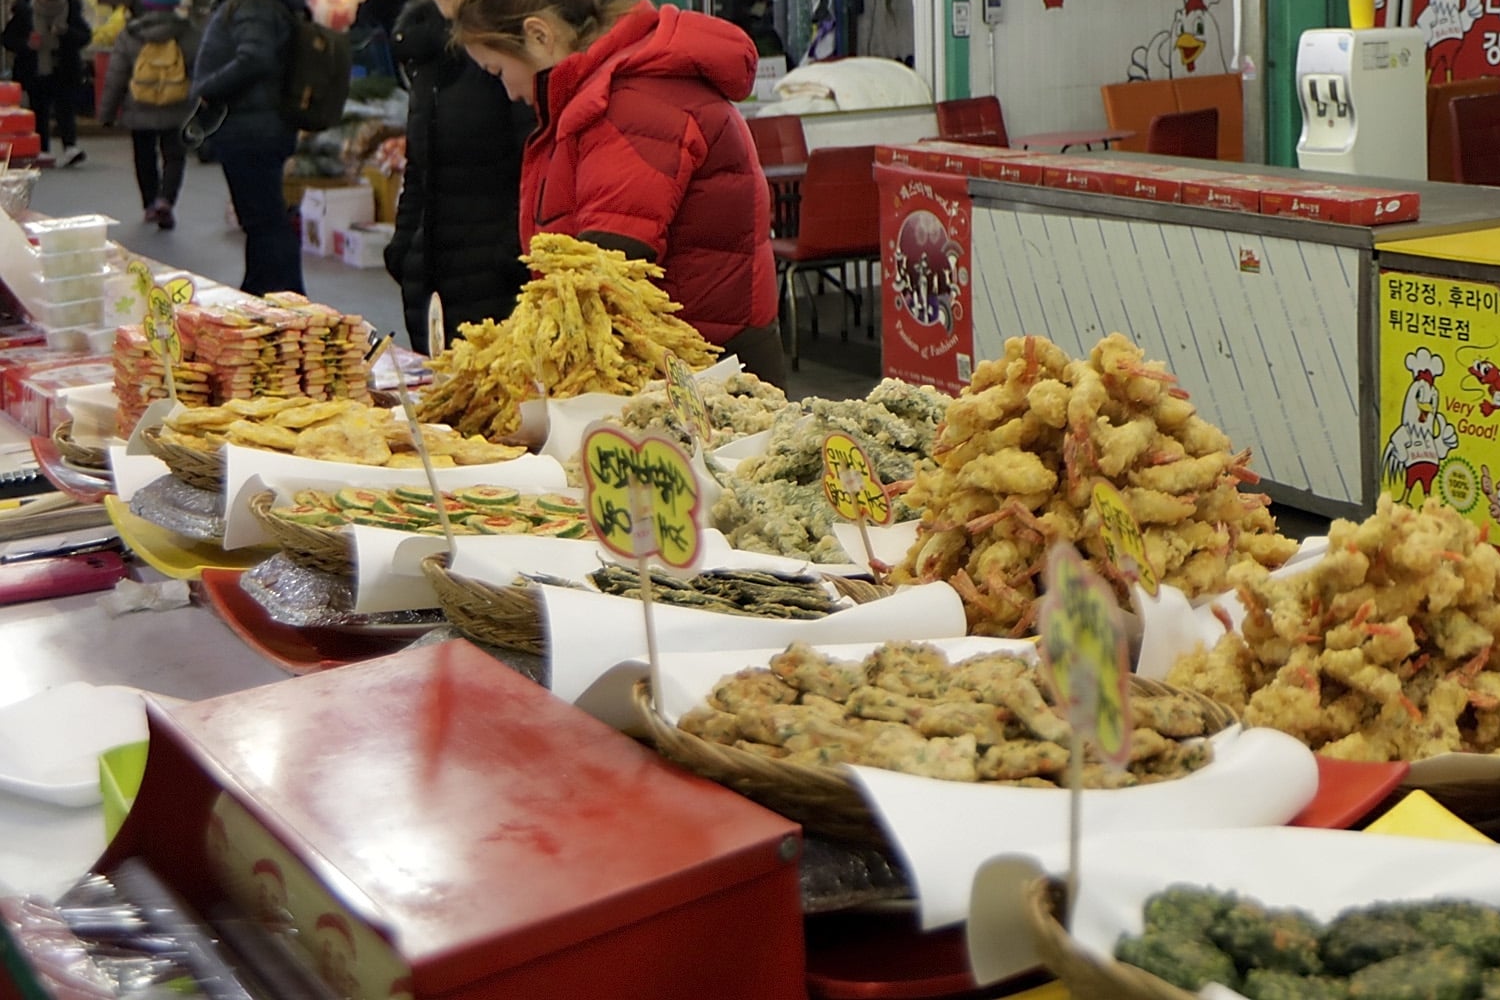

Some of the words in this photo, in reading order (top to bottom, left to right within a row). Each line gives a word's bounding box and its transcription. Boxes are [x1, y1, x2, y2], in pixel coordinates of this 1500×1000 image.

[1389, 309, 1471, 341] 튀김전문점
[1445, 396, 1475, 417] Very
[1457, 418, 1499, 442] Good!
